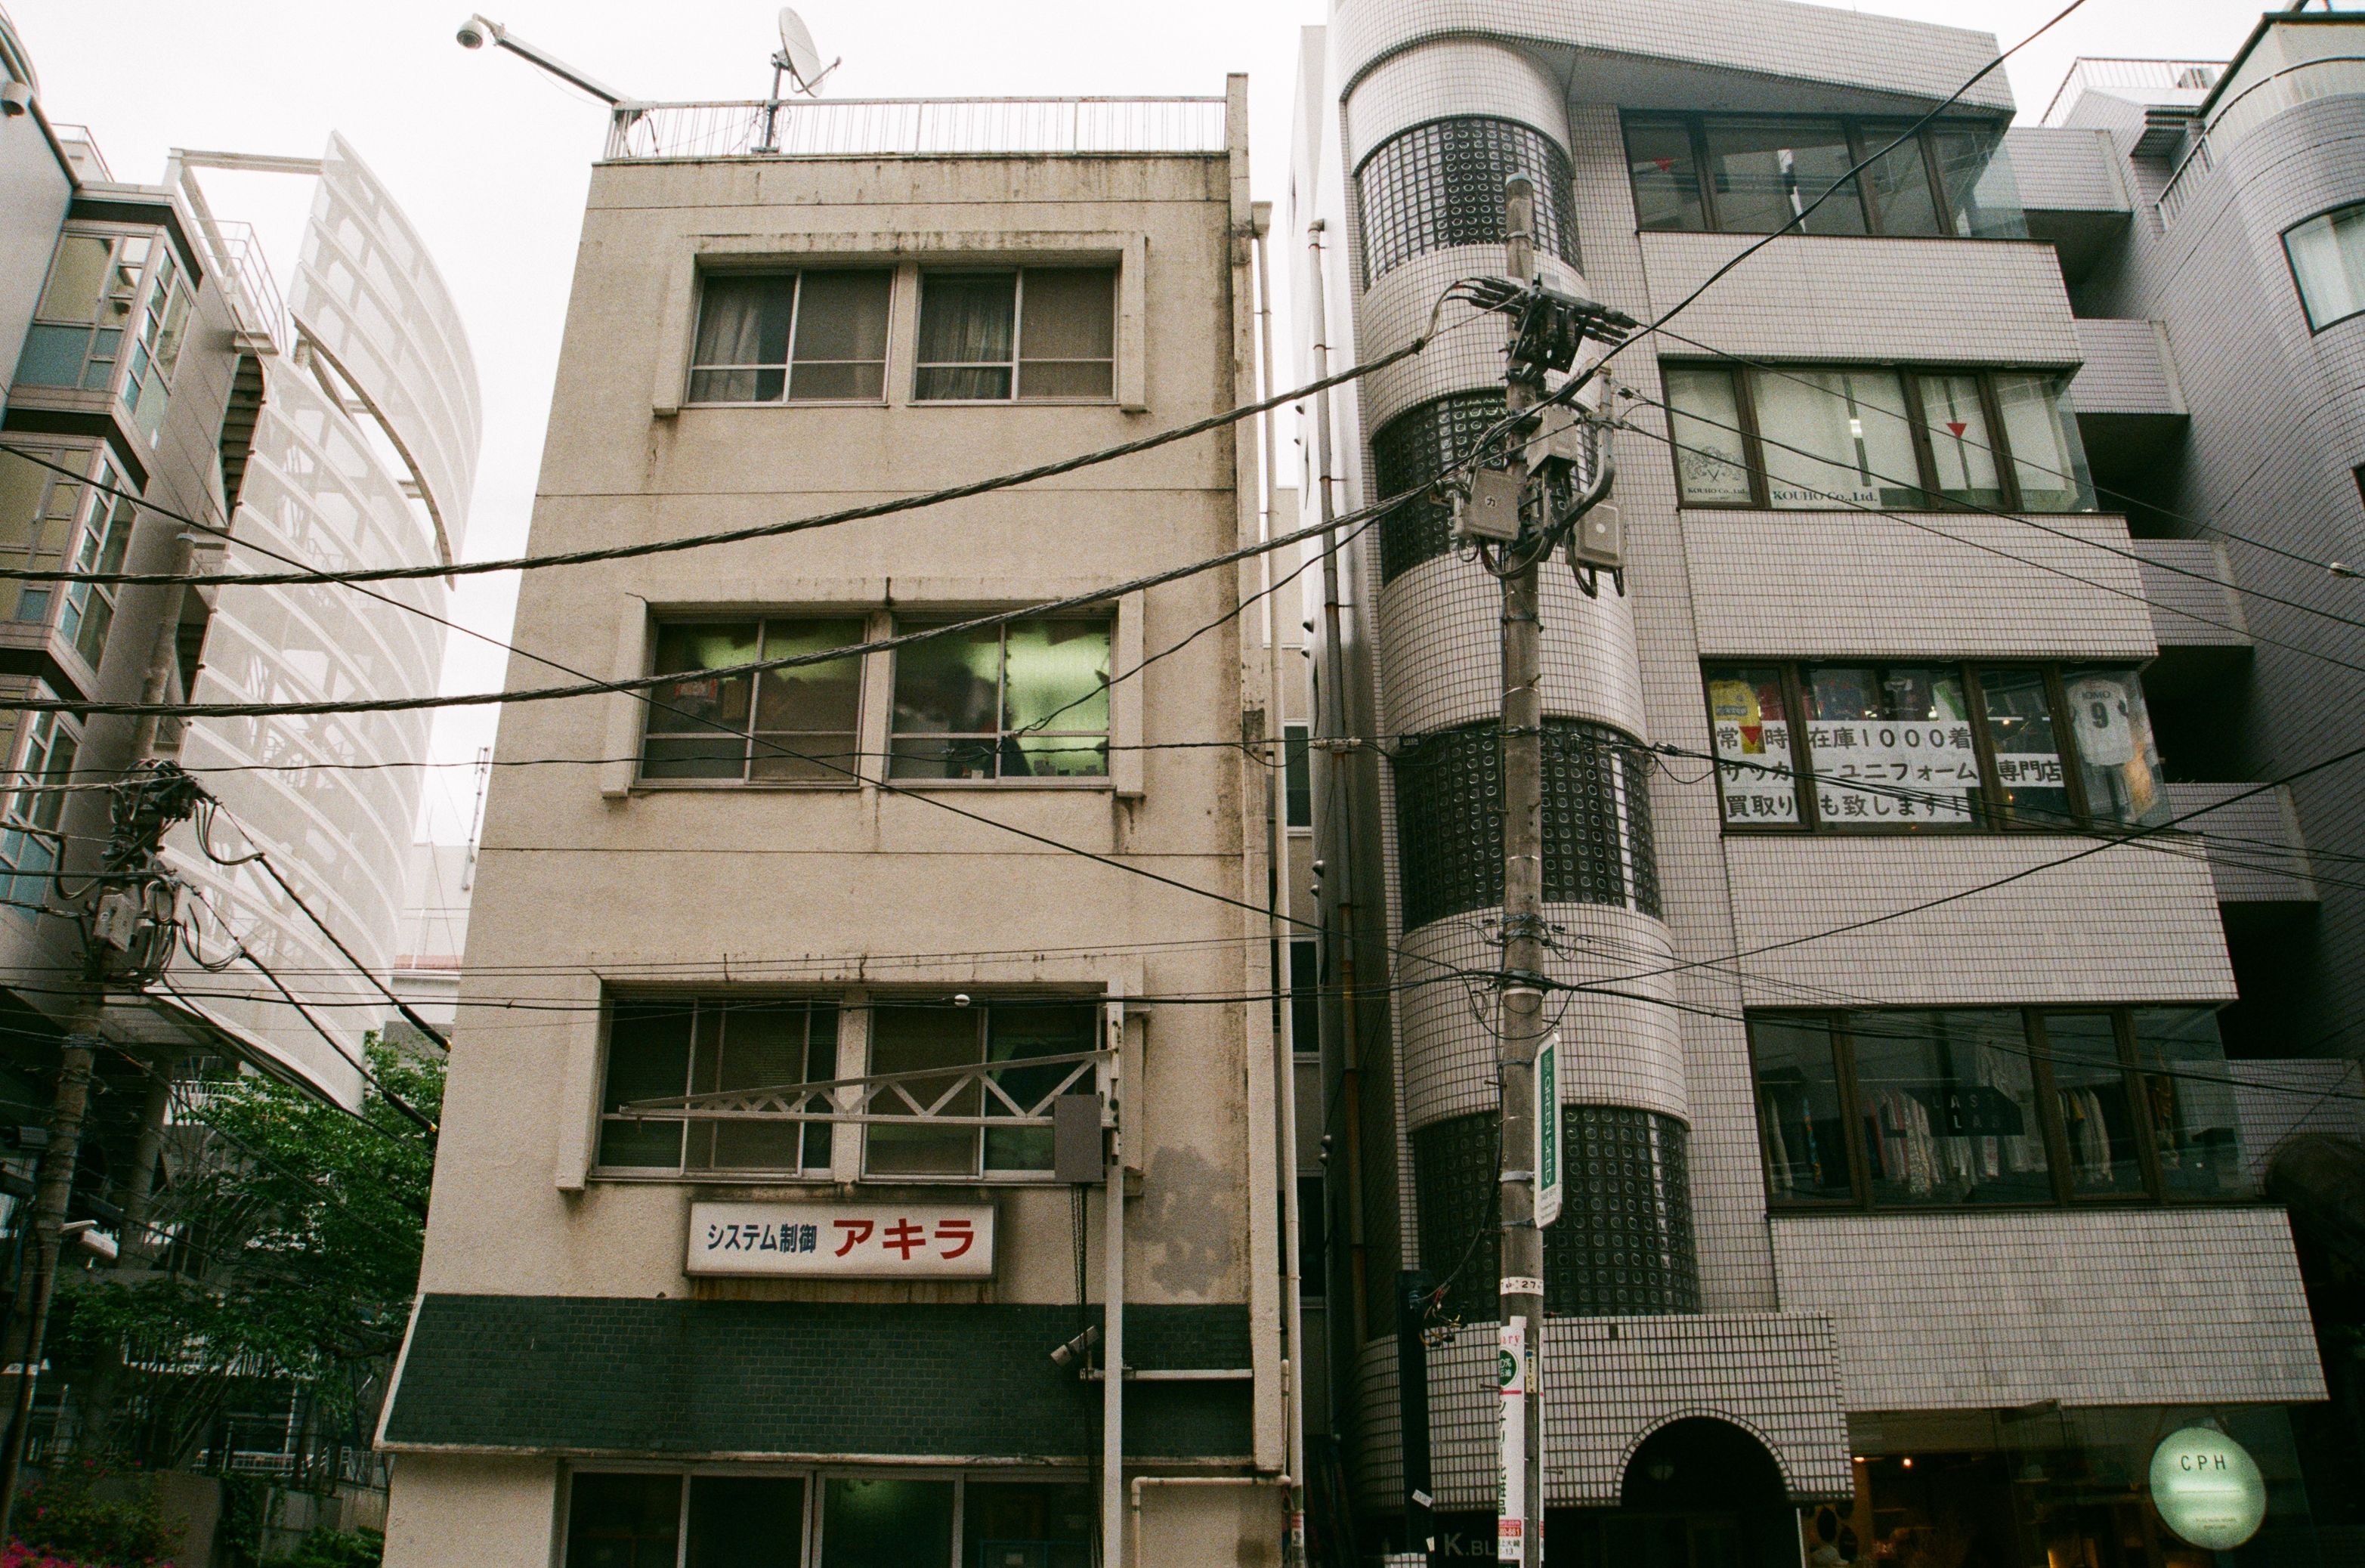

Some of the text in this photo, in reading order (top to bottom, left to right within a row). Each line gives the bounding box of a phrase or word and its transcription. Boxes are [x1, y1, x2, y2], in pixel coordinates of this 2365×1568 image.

[1773, 491, 1824, 501] KOUHO
[2091, 701, 2109, 729] 9
[1544, 1140, 1553, 1184] SEED
[707, 1218, 975, 1260] システム制御 アキラ
[2181, 1454, 2227, 1472] CPH
